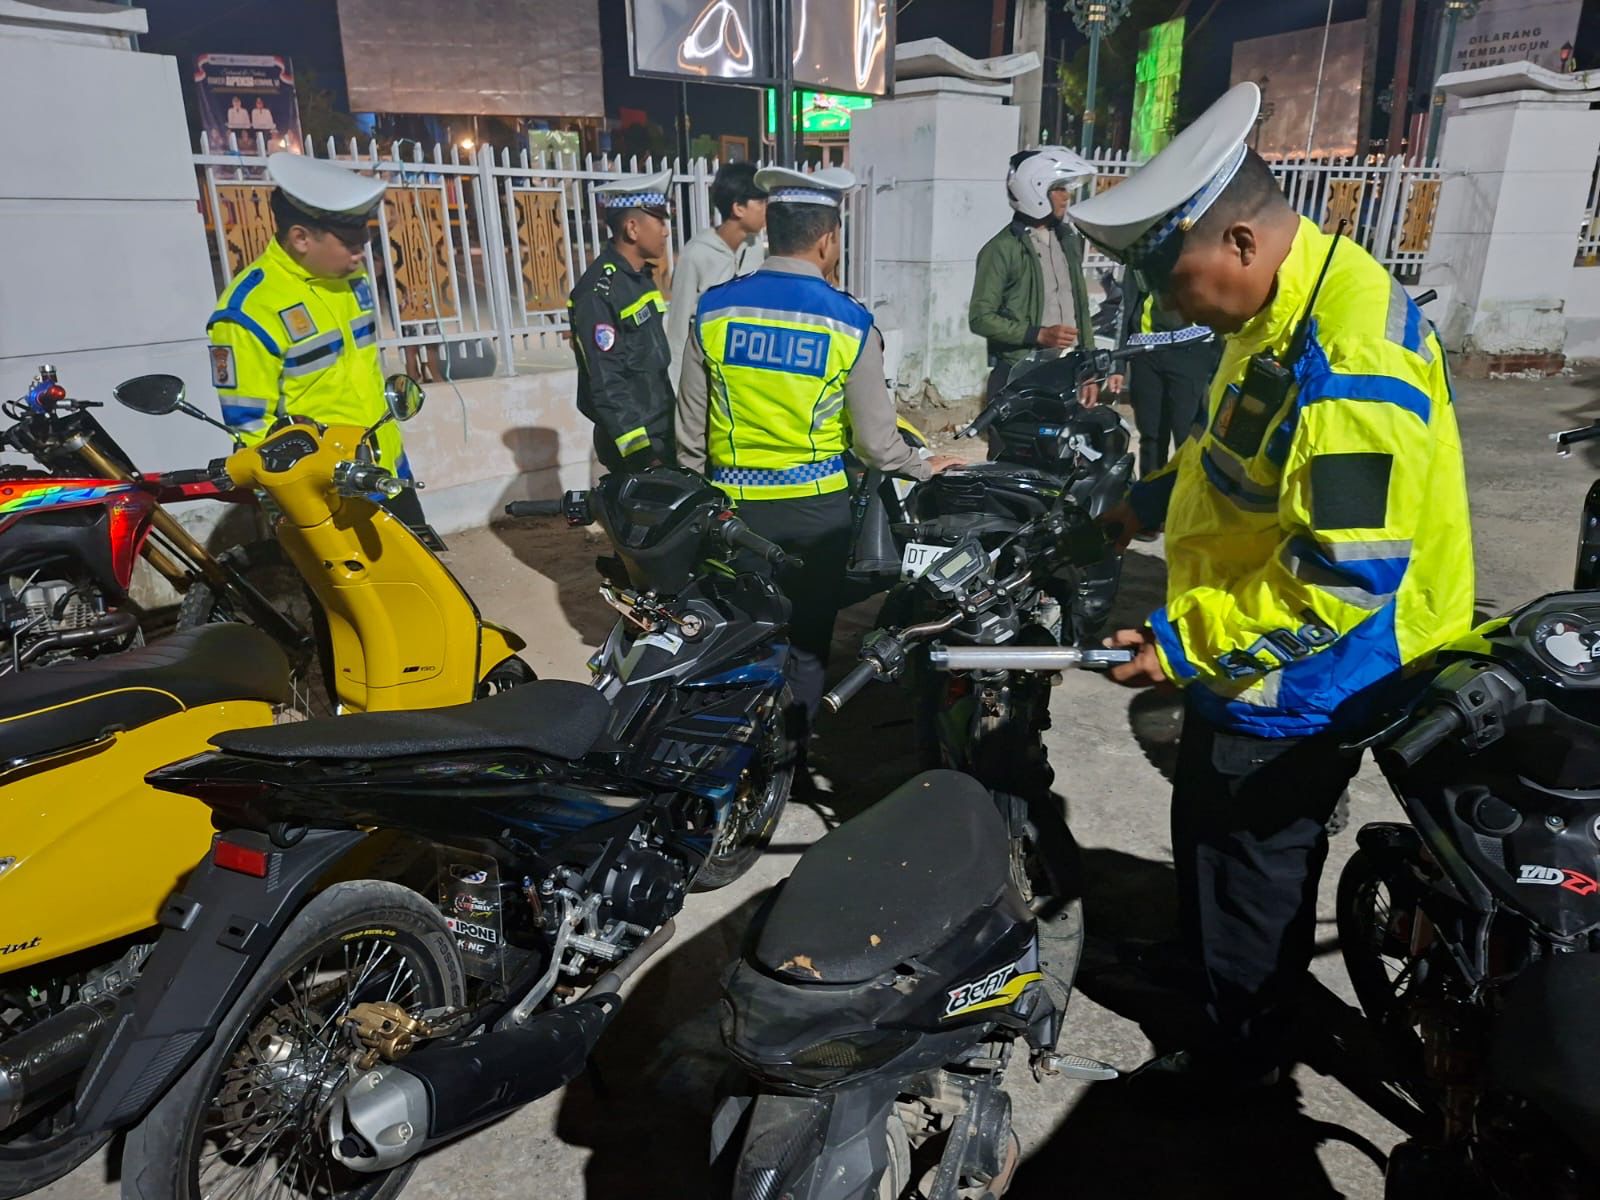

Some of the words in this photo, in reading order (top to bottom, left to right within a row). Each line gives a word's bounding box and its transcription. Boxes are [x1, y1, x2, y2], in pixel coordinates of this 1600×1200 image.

[1469, 28, 1542, 45] DILARANG
[1457, 40, 1549, 59] MEMBANGUN
[729, 328, 823, 369] POLISI
[908, 548, 927, 565] DT
[455, 921, 496, 941] IPONE
